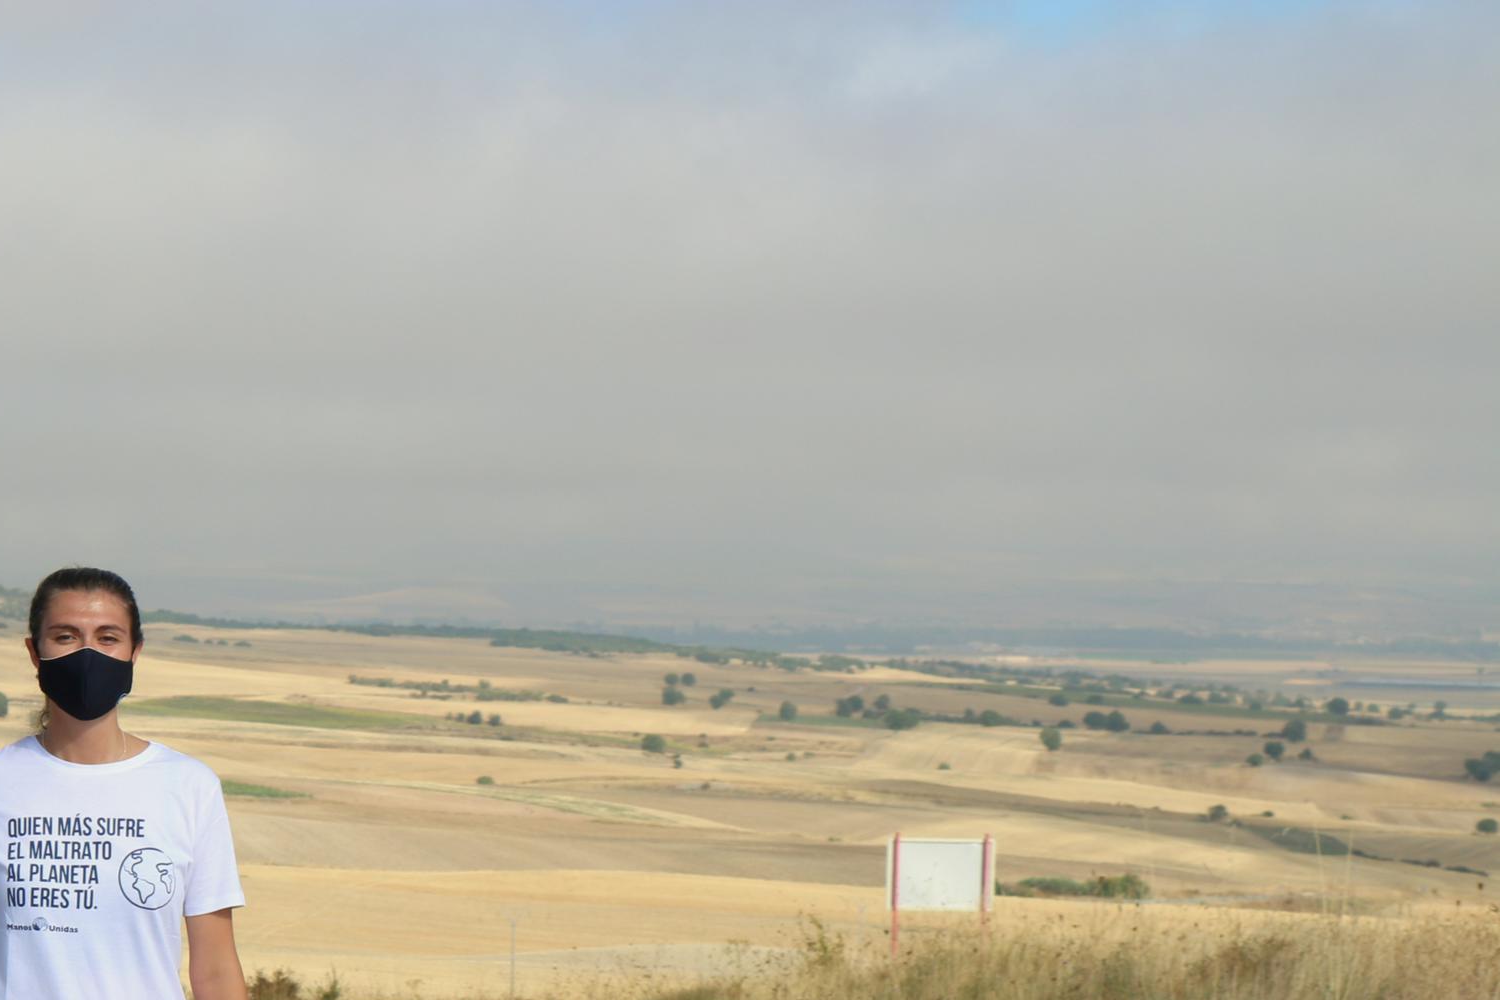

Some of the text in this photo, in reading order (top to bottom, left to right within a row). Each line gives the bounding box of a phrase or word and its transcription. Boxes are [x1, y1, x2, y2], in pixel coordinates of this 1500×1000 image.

[8, 813, 145, 838] QUIEN MÁS SUFRE
[8, 841, 112, 860] EL MALTRATO
[7, 863, 99, 885] AL PLANETA
[7, 885, 98, 910] NO ERES TÚ.
[7, 923, 79, 933] Manos Unidas
